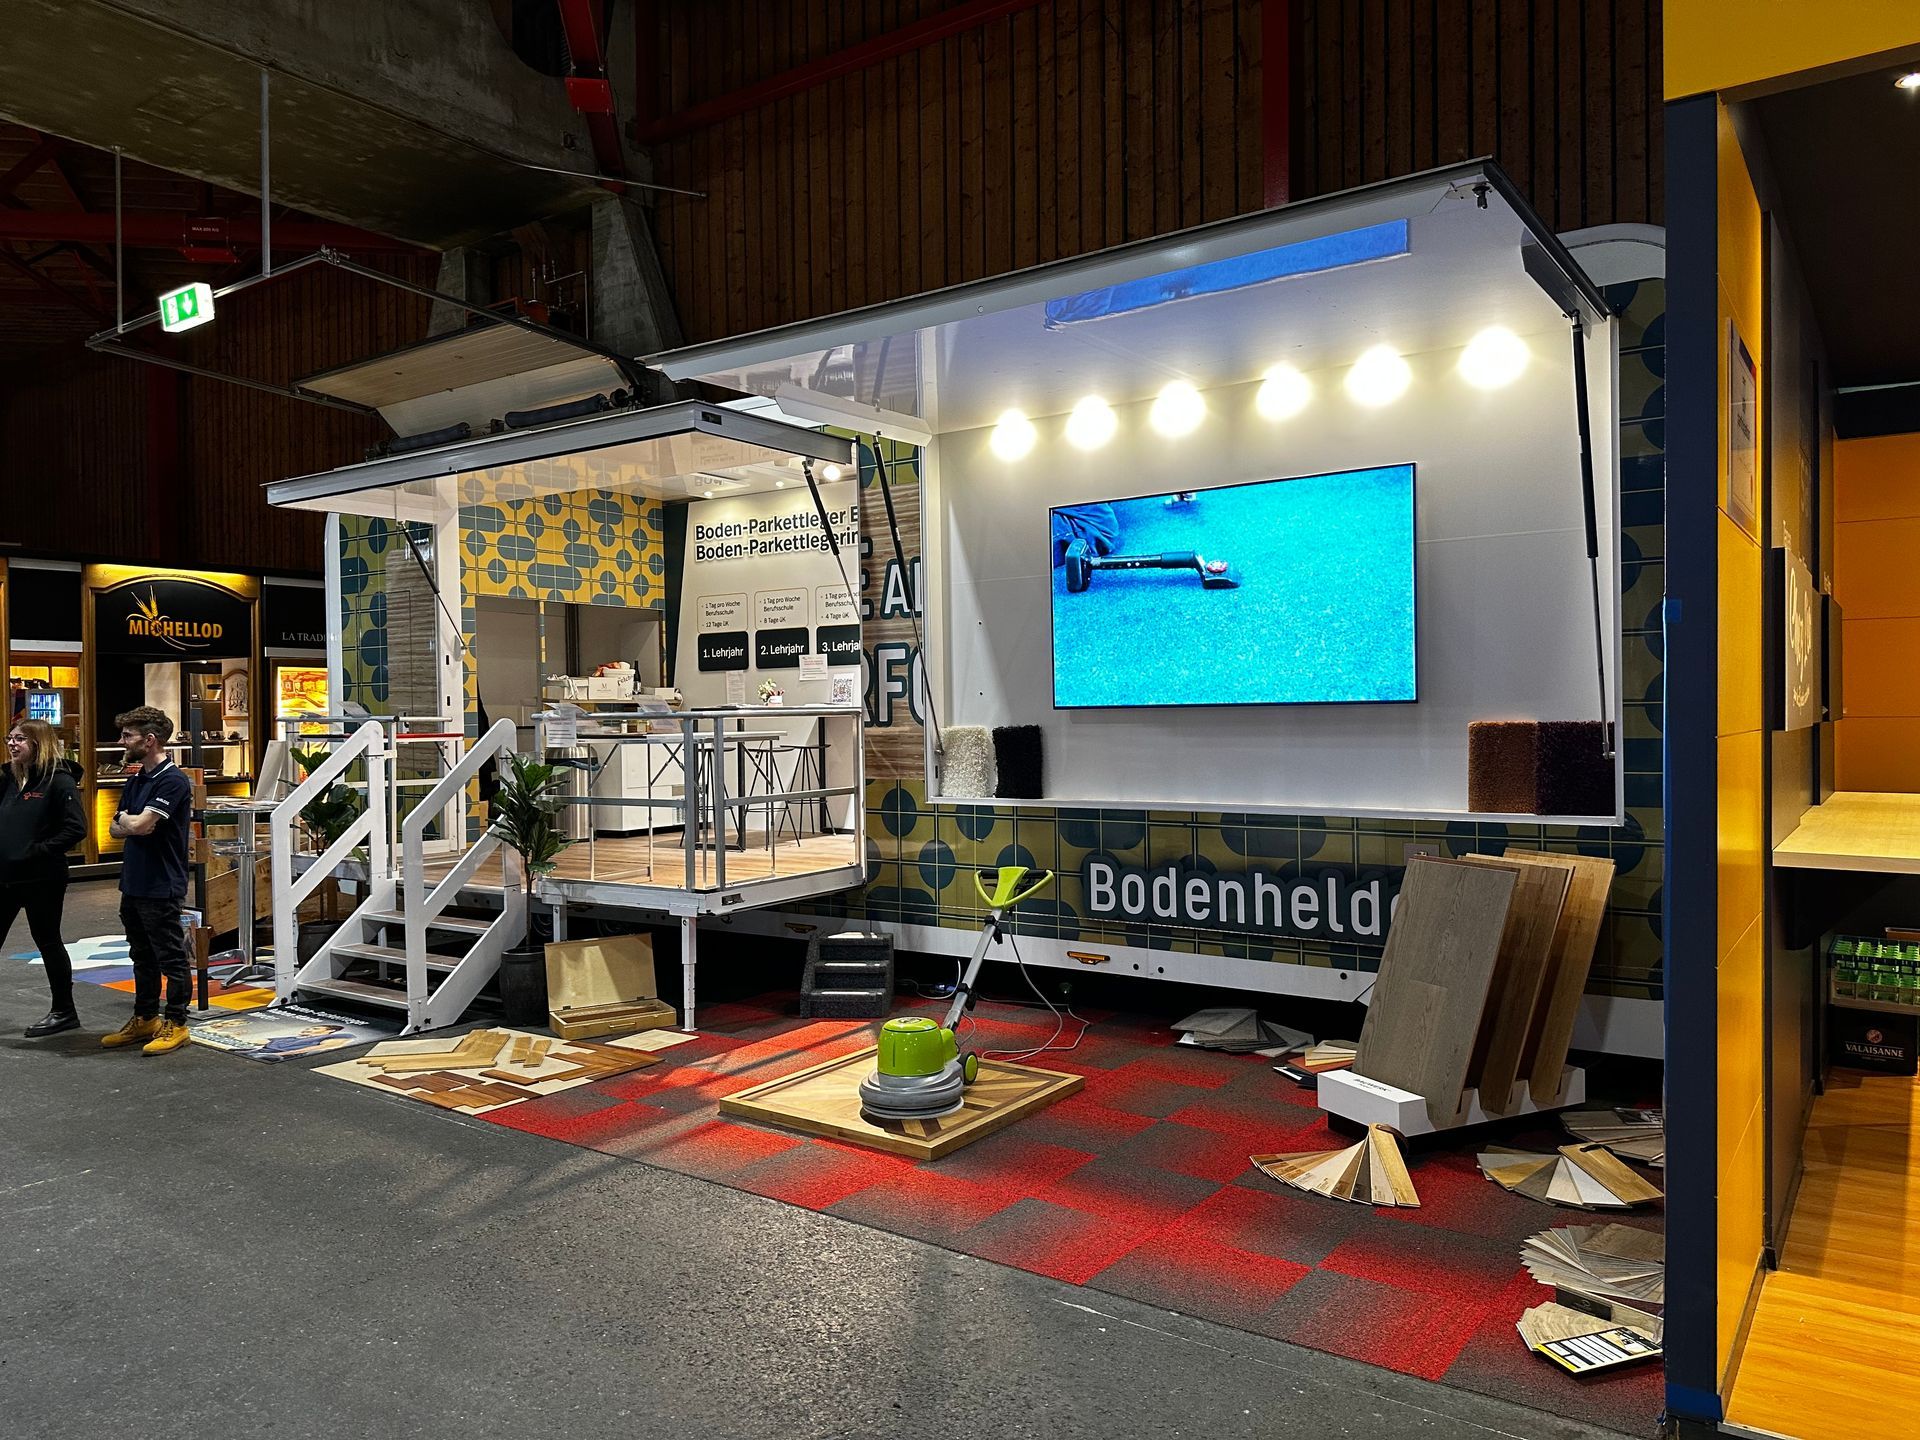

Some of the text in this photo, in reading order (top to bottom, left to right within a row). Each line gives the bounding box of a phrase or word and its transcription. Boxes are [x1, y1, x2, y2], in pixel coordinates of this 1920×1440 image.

[767, 597, 776, 605] Tag
[829, 592, 838, 600] Tag
[830, 612, 841, 620] Tage
[128, 619, 223, 639] MICHELLOD
[281, 632, 296, 641] LA
[760, 643, 804, 657] 2. Lehrjahr
[821, 641, 830, 652] 3.
[703, 647, 744, 660] 1. Lehrjahr
[1090, 862, 1401, 936] Bodenheld
[1845, 1043, 1904, 1058] VALAISANNE
